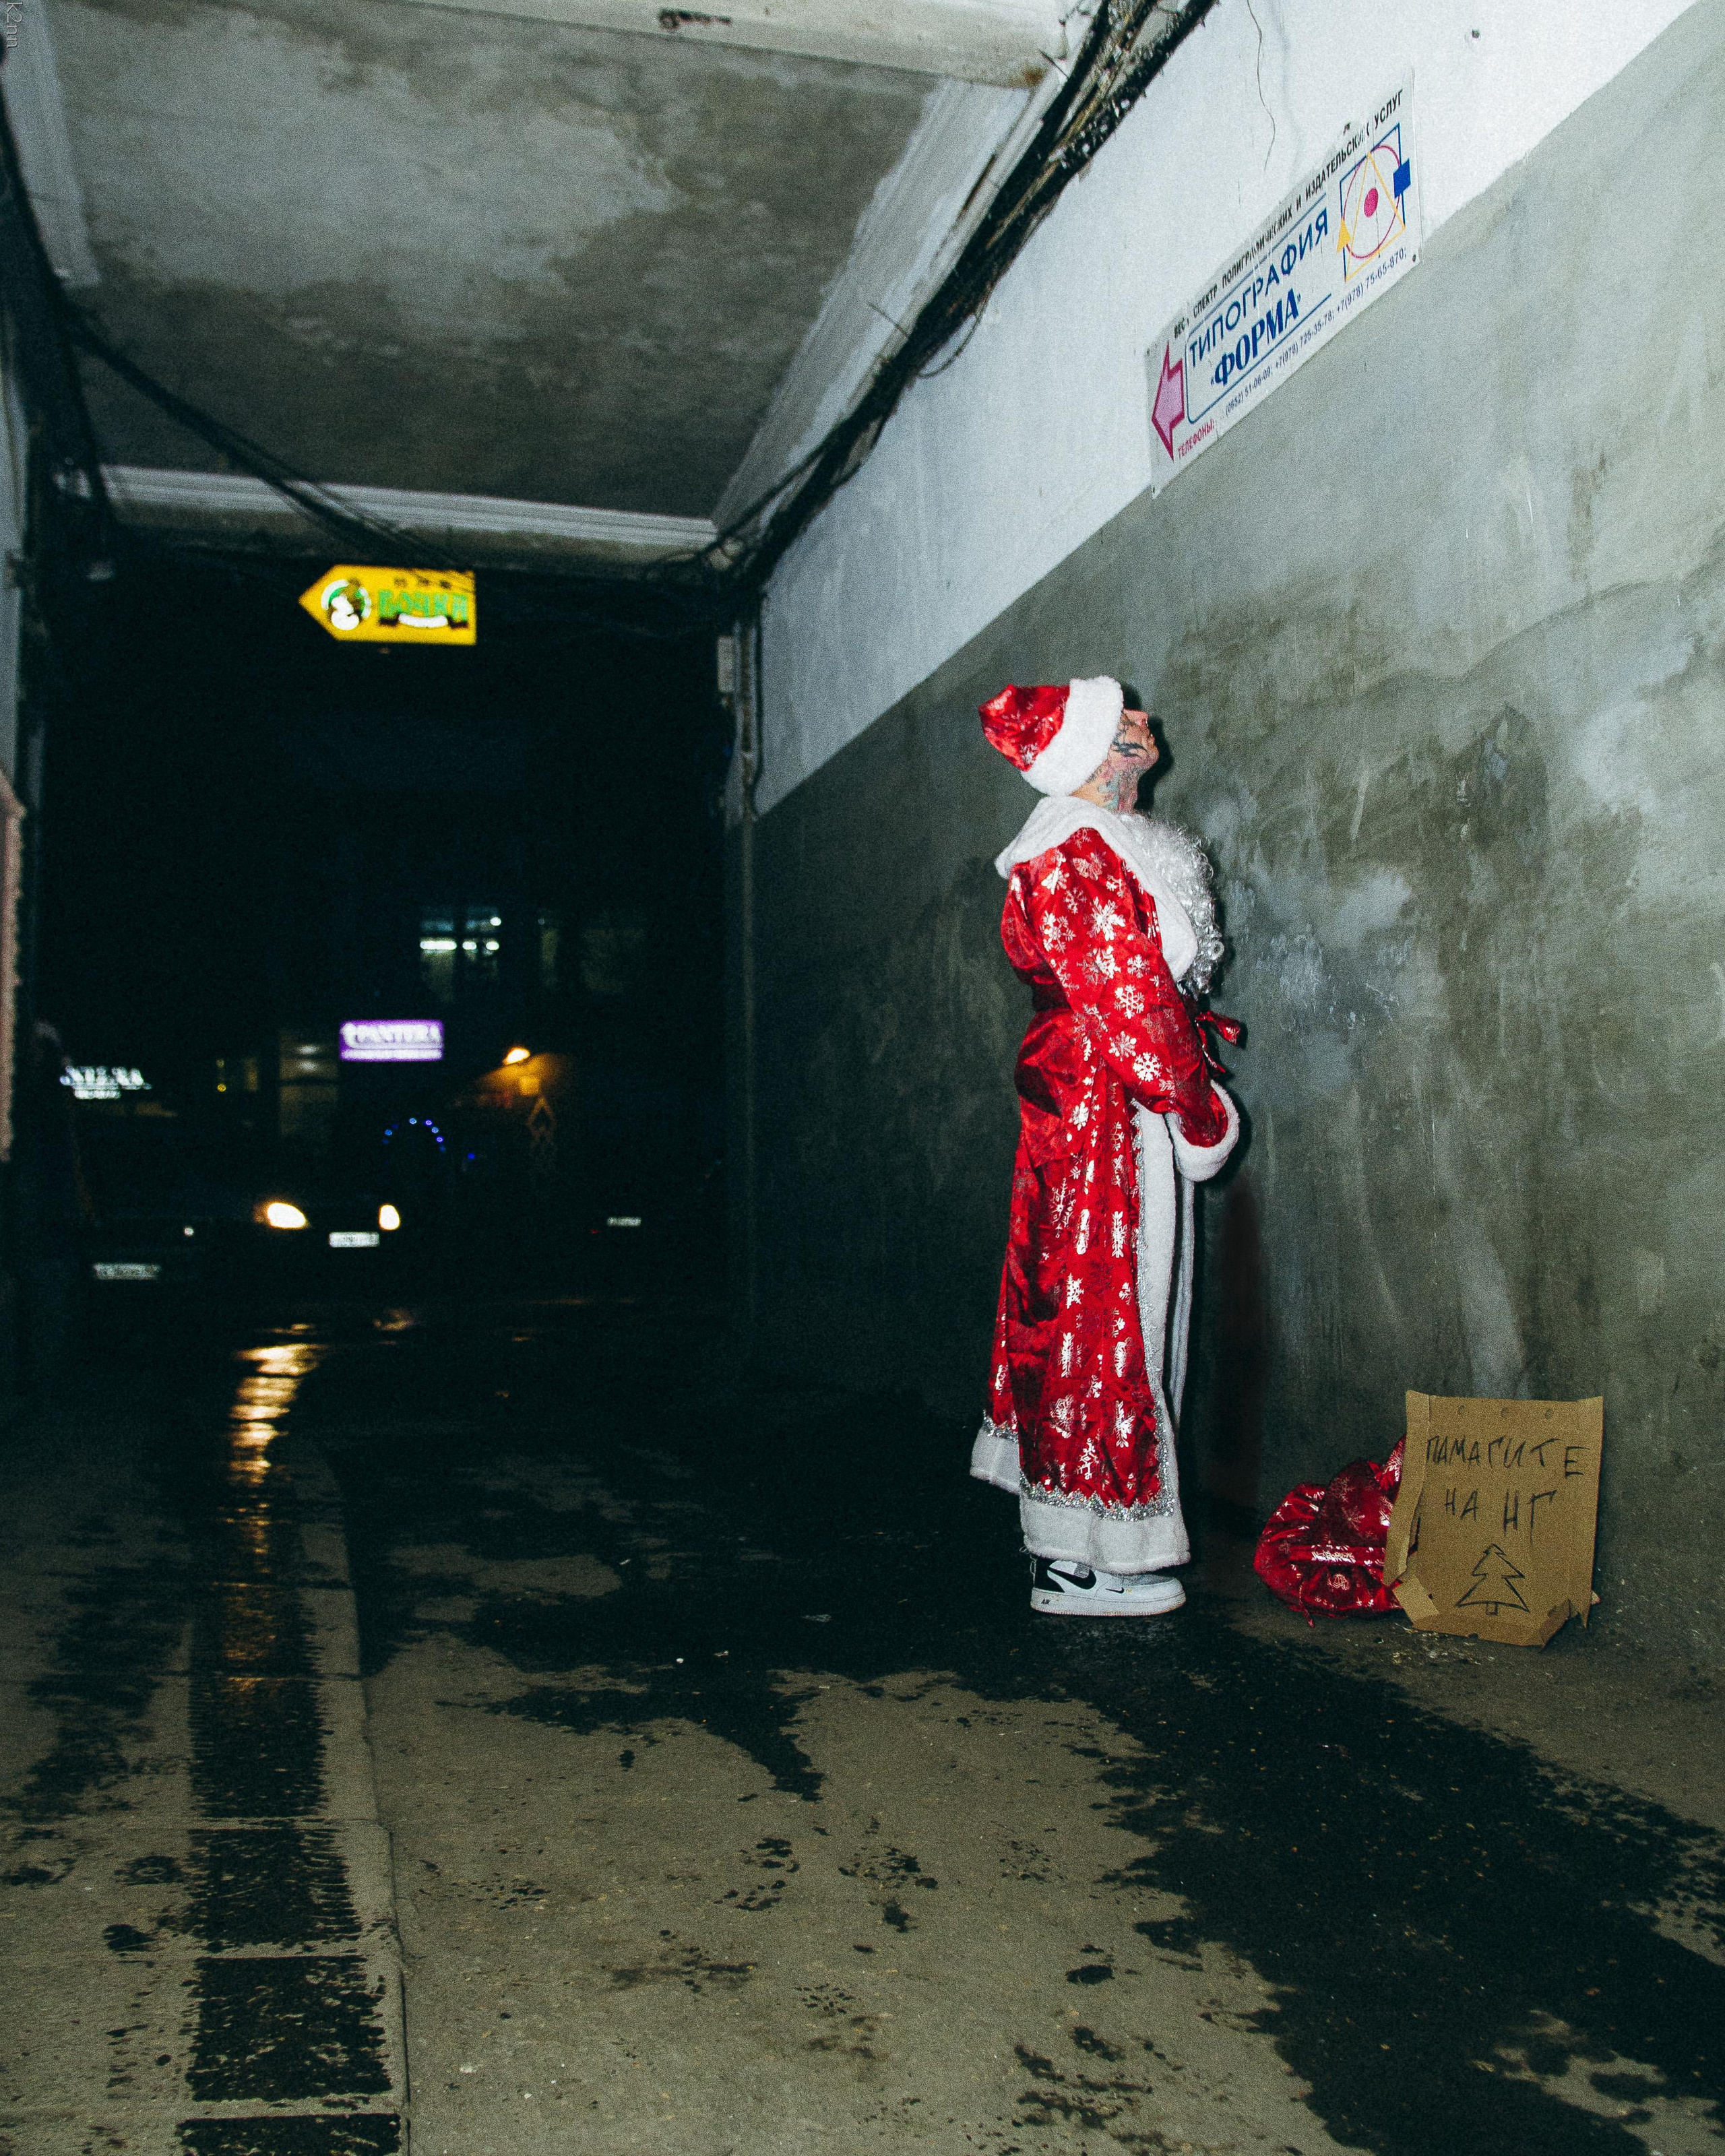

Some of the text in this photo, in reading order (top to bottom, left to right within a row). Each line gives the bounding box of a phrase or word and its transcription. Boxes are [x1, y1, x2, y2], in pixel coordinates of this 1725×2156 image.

[1193, 285, 1217, 319] СПЕКТР
[1296, 193, 1301, 212] И
[1374, 89, 1403, 129] УСЛУГ
[1189, 208, 1328, 369] ТИПОГРАФИЯ
[1210, 287, 1301, 387] «ФОРМА»
[1178, 418, 1214, 459] ТЕЛЕФОНЫ:
[1336, 284, 1362, 312] +7(978)
[1426, 1434, 1591, 1478] ПАМАГИТЕ
[1444, 1488, 1558, 1547] НА НГ
